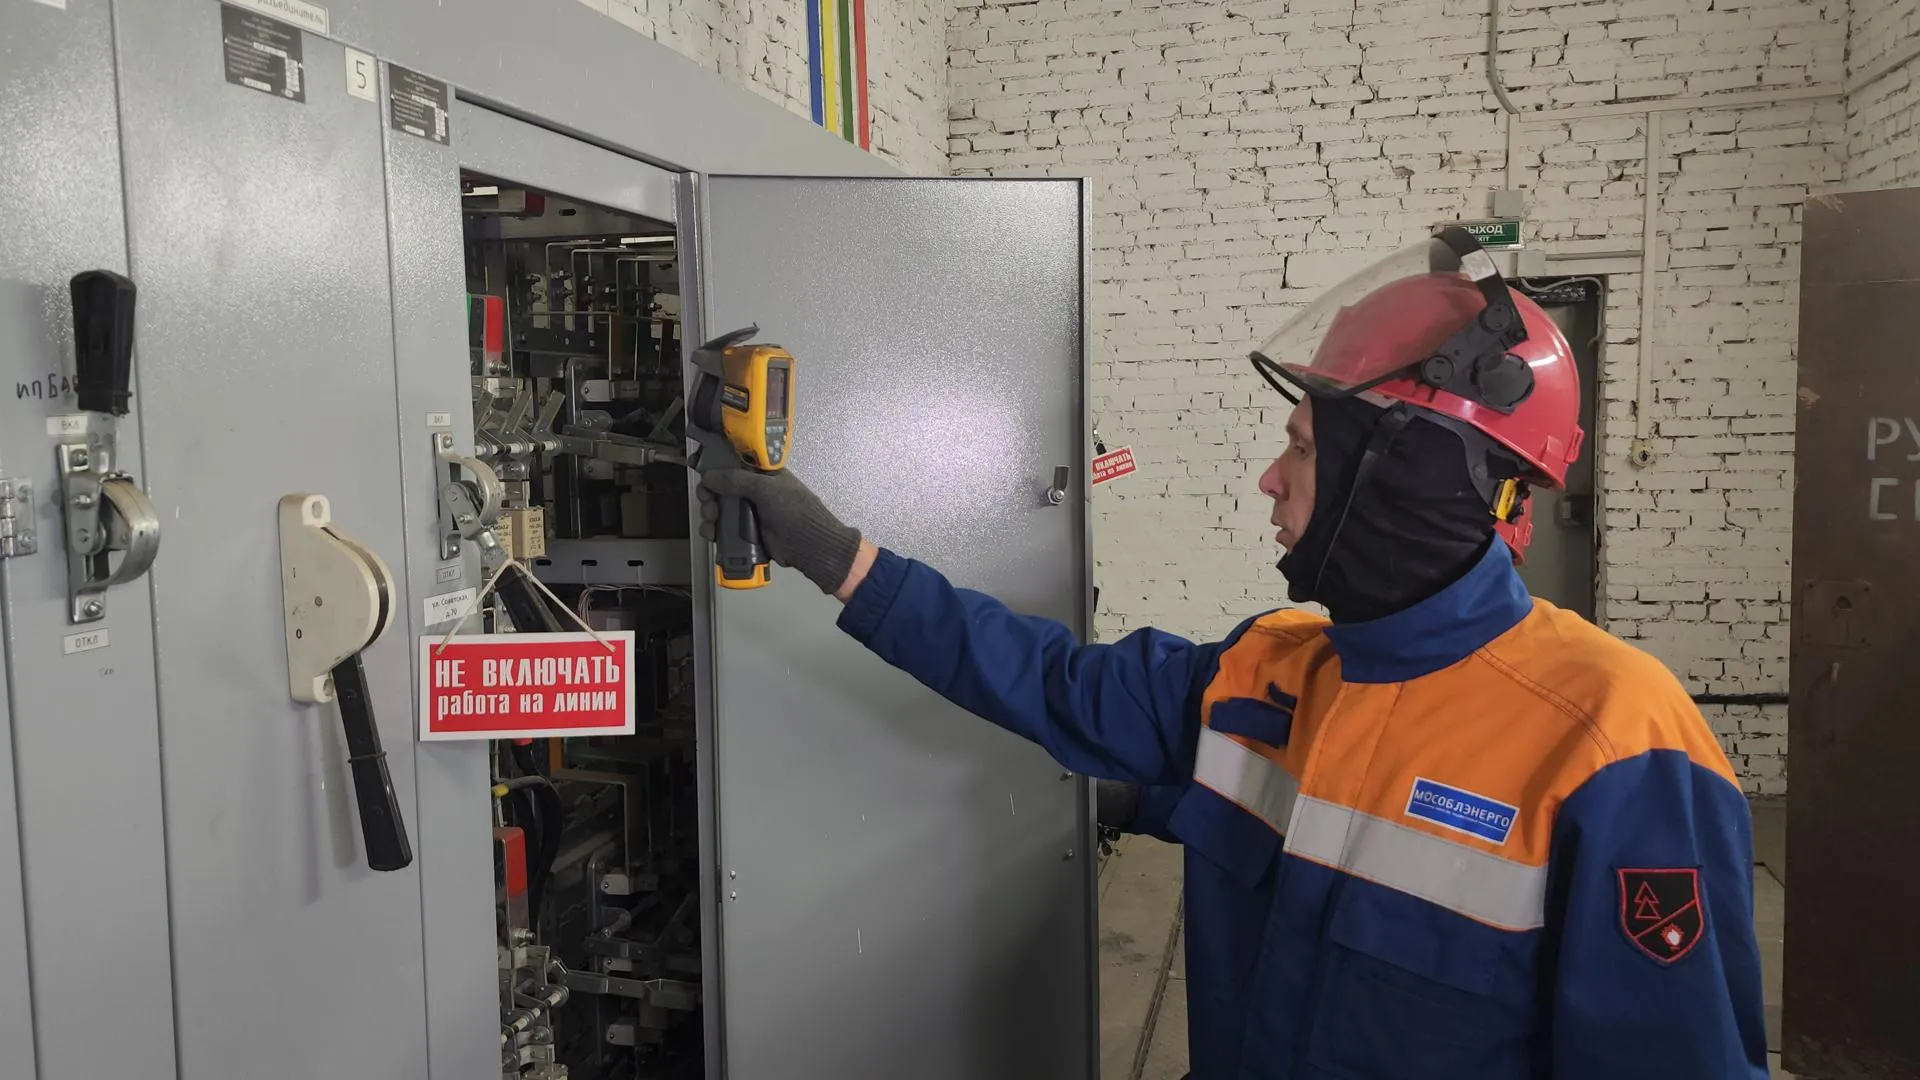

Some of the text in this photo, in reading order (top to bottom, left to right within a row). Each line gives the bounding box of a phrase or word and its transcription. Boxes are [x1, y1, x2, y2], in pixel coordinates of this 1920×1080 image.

[356, 60, 367, 89] 5
[1464, 225, 1503, 234] ЫХОД
[61, 420, 80, 430] ВКЛ
[75, 635, 98, 648] ОТКЛ
[435, 656, 620, 688] НЕ ВКЛЮЧАТЬ
[437, 690, 617, 720] работа на линии
[1414, 789, 1510, 827] МОСОБЛЭНЕРГО
